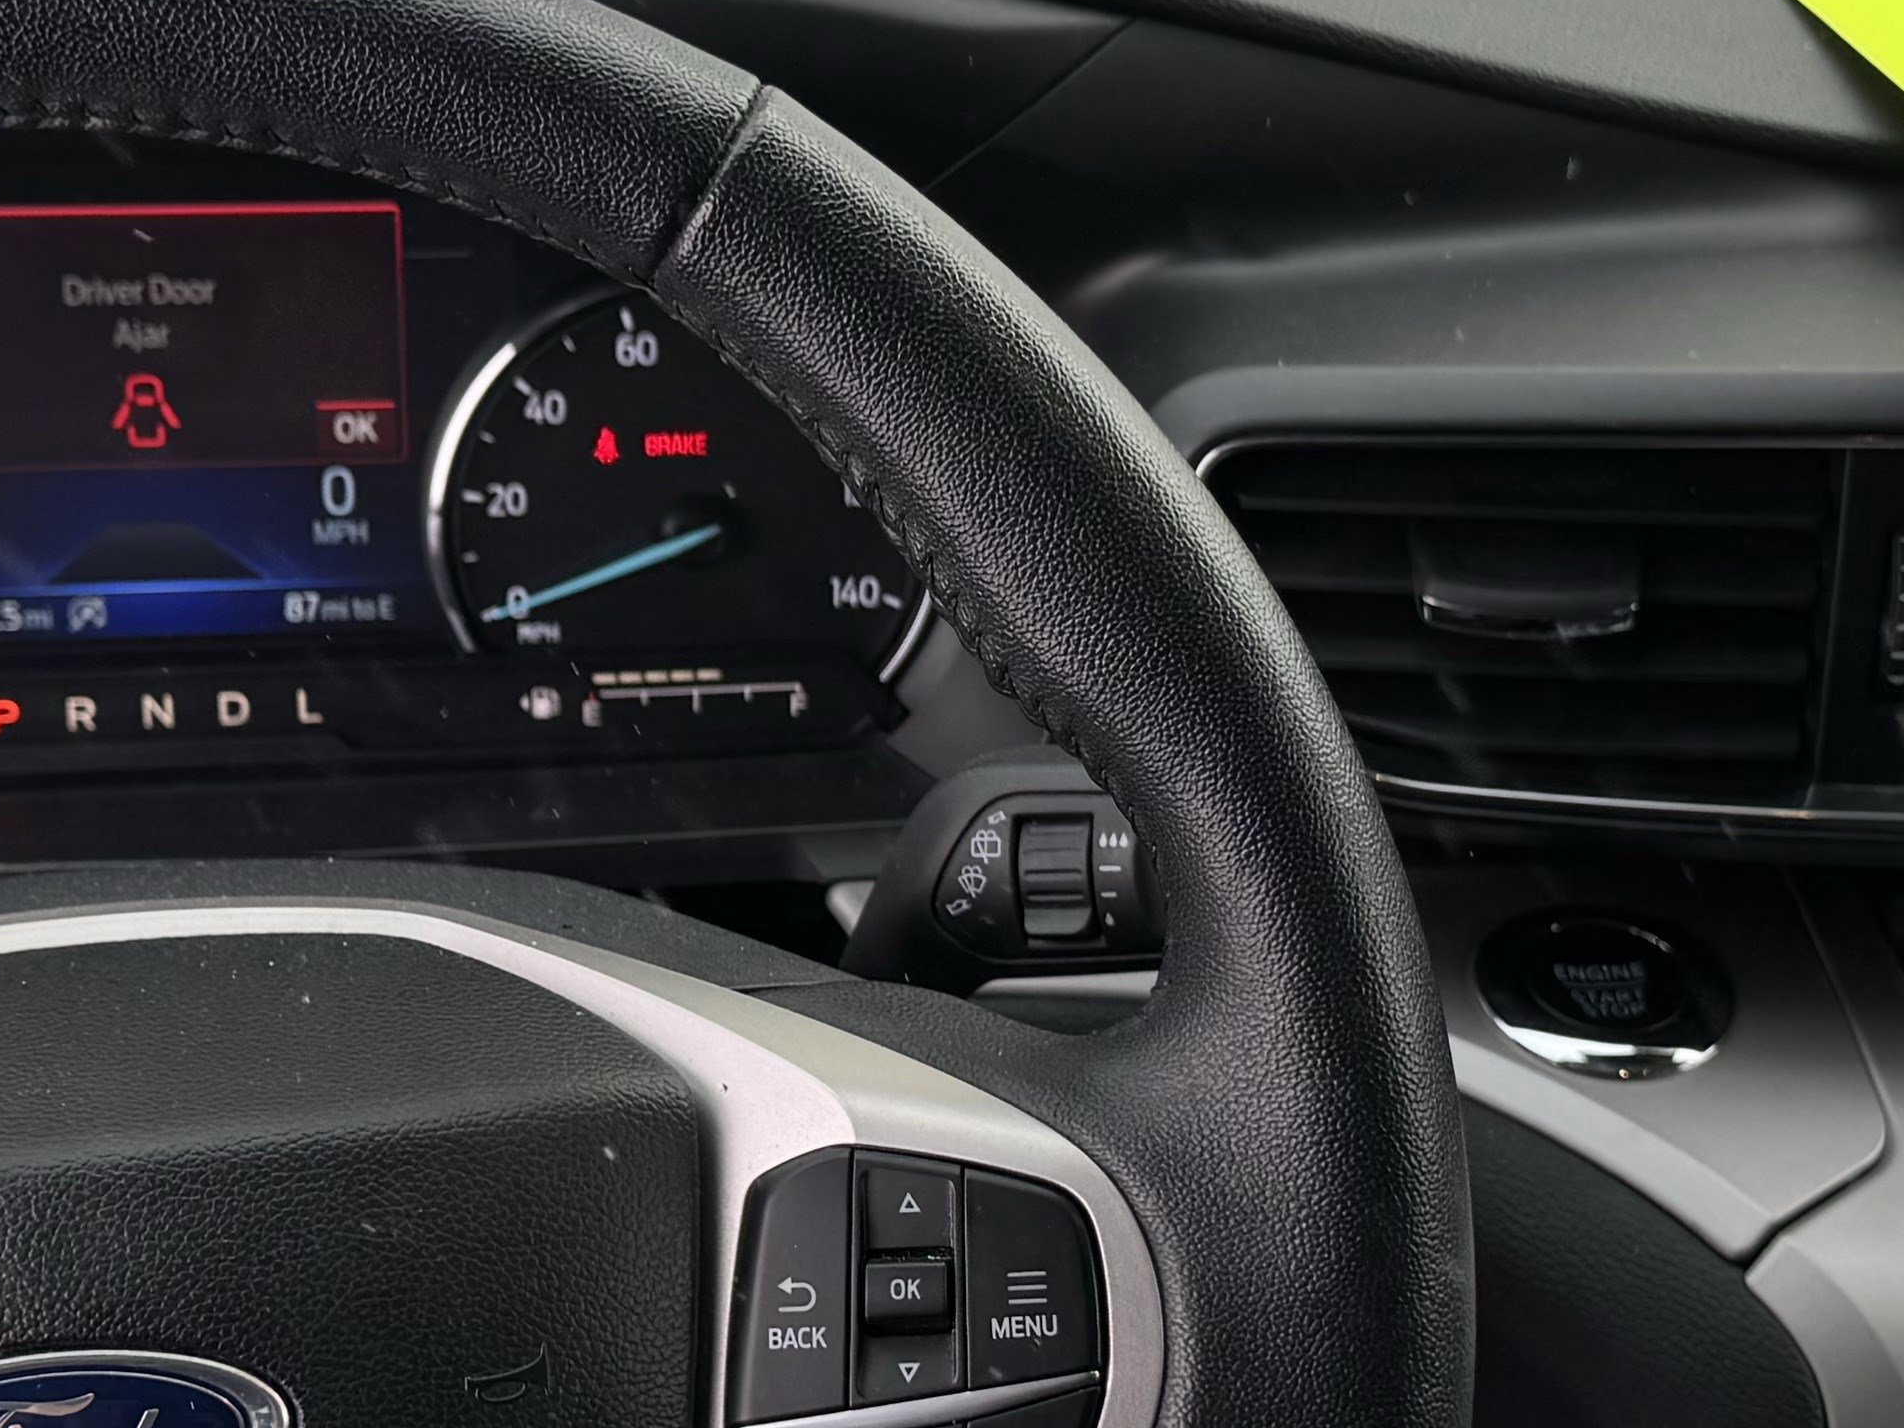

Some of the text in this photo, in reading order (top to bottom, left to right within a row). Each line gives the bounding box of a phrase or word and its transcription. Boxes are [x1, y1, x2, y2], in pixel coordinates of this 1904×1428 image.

[62, 274, 216, 307] Driver Door
[112, 318, 171, 354] Ajar
[616, 334, 658, 367] 60
[523, 391, 567, 426] 40
[332, 411, 380, 445] OK
[644, 432, 708, 457] BRAKE
[321, 465, 356, 517] 0
[487, 483, 528, 517] 20
[831, 576, 880, 609] 140
[517, 624, 560, 645] MPH
[65, 695, 97, 733] R
[141, 693, 174, 730] N
[216, 691, 251, 727] D
[296, 688, 323, 724] L
[1552, 961, 1647, 983] ENGINE
[889, 1279, 922, 1302] OK
[767, 1326, 828, 1351] BACK
[990, 1313, 1059, 1340] MENU
